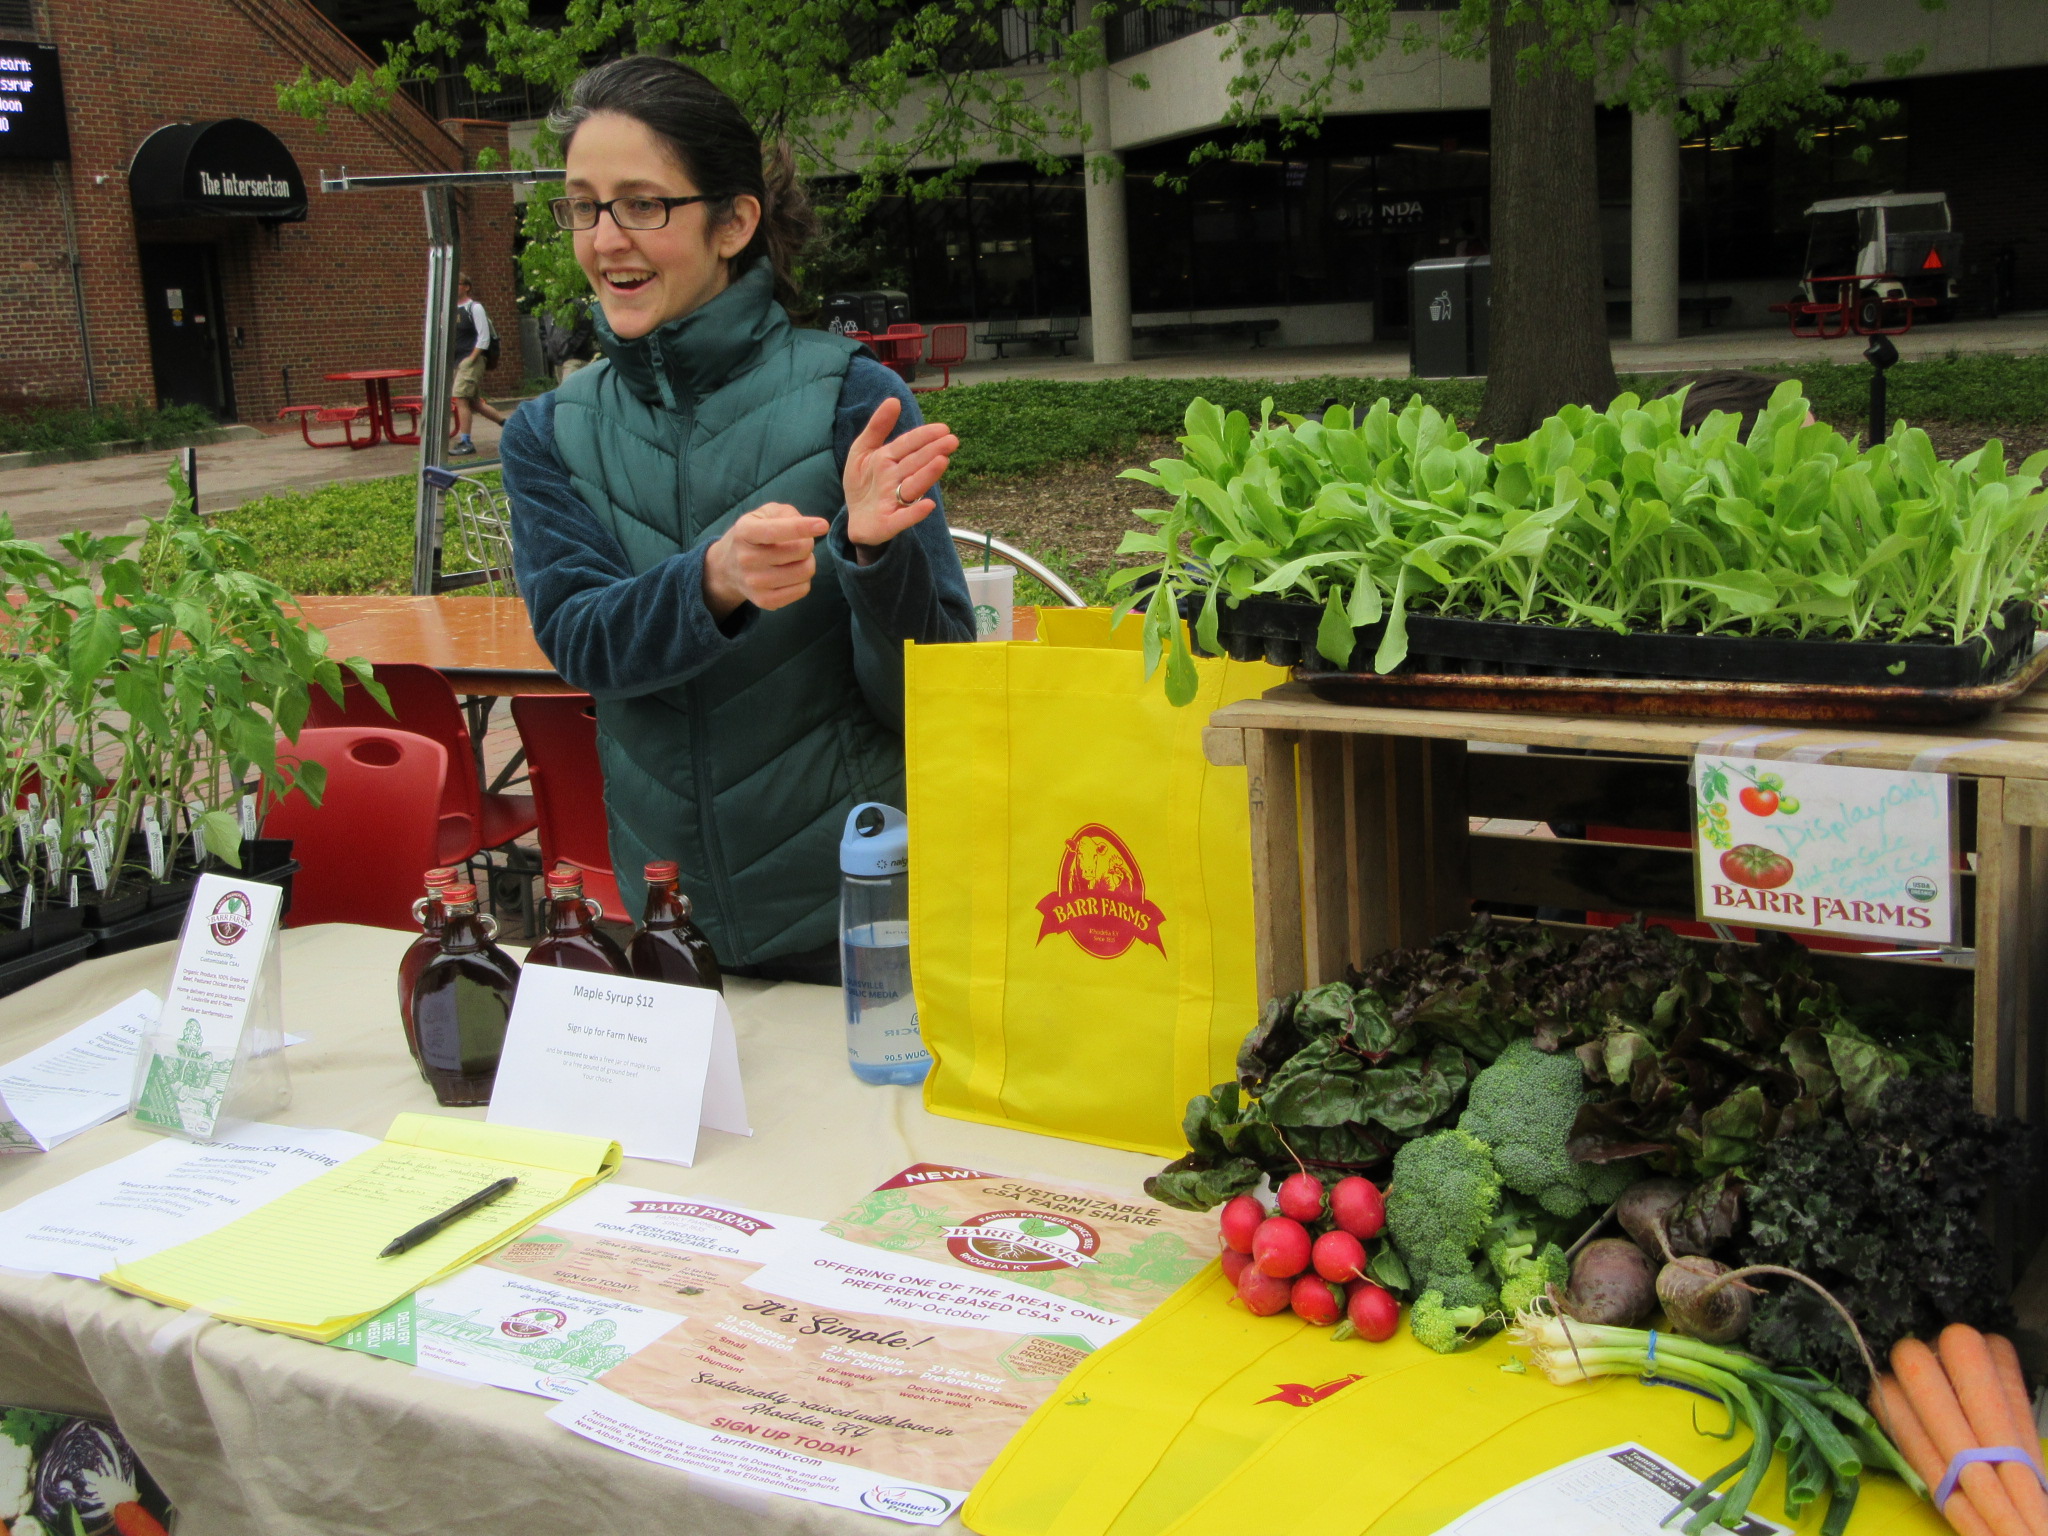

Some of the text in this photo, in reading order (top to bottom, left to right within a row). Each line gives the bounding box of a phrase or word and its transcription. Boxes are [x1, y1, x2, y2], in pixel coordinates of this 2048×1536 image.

[0, 58, 31, 71] earn:
[200, 171, 290, 197] The intersection
[1765, 796, 1887, 857] Display
[1052, 897, 1151, 931] BARR FARMS
[1711, 883, 1932, 928] BARR FARMS
[211, 914, 248, 928] BARR FARMS
[573, 985, 654, 1008] Maple Syrup $12
[868, 991, 899, 999] MEDIA
[567, 1023, 648, 1044] Sign Up for Farm News
[563, 1049, 582, 1058] entered
[603, 1056, 614, 1064] free
[630, 1061, 647, 1070] maple
[647, 1064, 661, 1073] syrup
[573, 1061, 626, 1076] free pound ground
[884, 1053, 903, 1062] 90.5
[263, 1145, 290, 1153] CSA
[291, 1148, 340, 1167] Pricing
[982, 1187, 1162, 1227] CSA FARM SHARE
[1001, 1183, 1162, 1217] CUSTOMIZABLE
[640, 1203, 761, 1231] BARR FARMS
[978, 1212, 1091, 1238] FAMILY FARMERS SINCE
[594, 1222, 740, 1255] FROM CUSTOMIZABLE CSA
[630, 1223, 718, 1243] FRESH PRODUCE
[953, 1228, 1085, 1263] BARR FARMS
[959, 1252, 1009, 1271] RHODELIA
[553, 1271, 580, 1280] SIGN
[814, 1259, 1121, 1327] OFFERING ONE OF THE AREA'S ONLY
[841, 1278, 1061, 1323] PREFERENCE-BASED CSAs
[884, 1297, 991, 1322] May-October
[367, 1320, 381, 1348] WEEKLY
[382, 1321, 396, 1342] HERE
[397, 1311, 410, 1346] DELIVERY
[715, 1322, 794, 1351] subscription
[724, 1315, 789, 1340] 1) Choose
[742, 1300, 935, 1350] It's Simple!
[707, 1345, 746, 1362] Regular
[719, 1336, 748, 1350] Small
[1027, 1345, 1082, 1364] ORGANIC
[695, 1354, 745, 1374] Abundant
[819, 1351, 850, 1364] Your
[825, 1345, 906, 1366] 2) Schedule
[1019, 1350, 1078, 1369] PRODUCE
[816, 1375, 855, 1389] Weekly
[826, 1367, 877, 1382] Bi-weekly
[919, 1372, 1002, 1393] Preferences
[926, 1364, 1006, 1386] 3) Set Your
[1031, 1368, 1046, 1376] Pork
[690, 1370, 955, 1437] Sustainably-raised with love in
[898, 1391, 974, 1410] week-to-week.
[906, 1384, 944, 1396] Decide
[945, 1391, 973, 1401] what
[988, 1398, 1028, 1411] receive
[741, 1402, 875, 1438] Rhodelia, KY
[710, 1416, 864, 1458] SIGN UP TODAY
[574, 1419, 593, 1432] New
[595, 1429, 626, 1445] Albany,
[664, 1452, 722, 1472] Brandenburg,
[723, 1468, 743, 1477] and
[742, 1472, 808, 1493] Elizabethtown.
[582, 1414, 840, 1493] Louisville, St. Matthews, Middletown, Highlands, Springhurst,
[618, 1421, 654, 1438] delivery
[665, 1437, 685, 1448] pick
[686, 1444, 698, 1452] up
[699, 1446, 741, 1460] locations
[750, 1458, 798, 1475] Downtown
[800, 1471, 819, 1480] and
[819, 1475, 837, 1483] Old
[711, 1434, 823, 1467] barrfarmsky.com
[1630, 1451, 1661, 1471] Tammy
[1661, 1470, 1691, 1490] Warren
[882, 1497, 940, 1514] Kentucky
